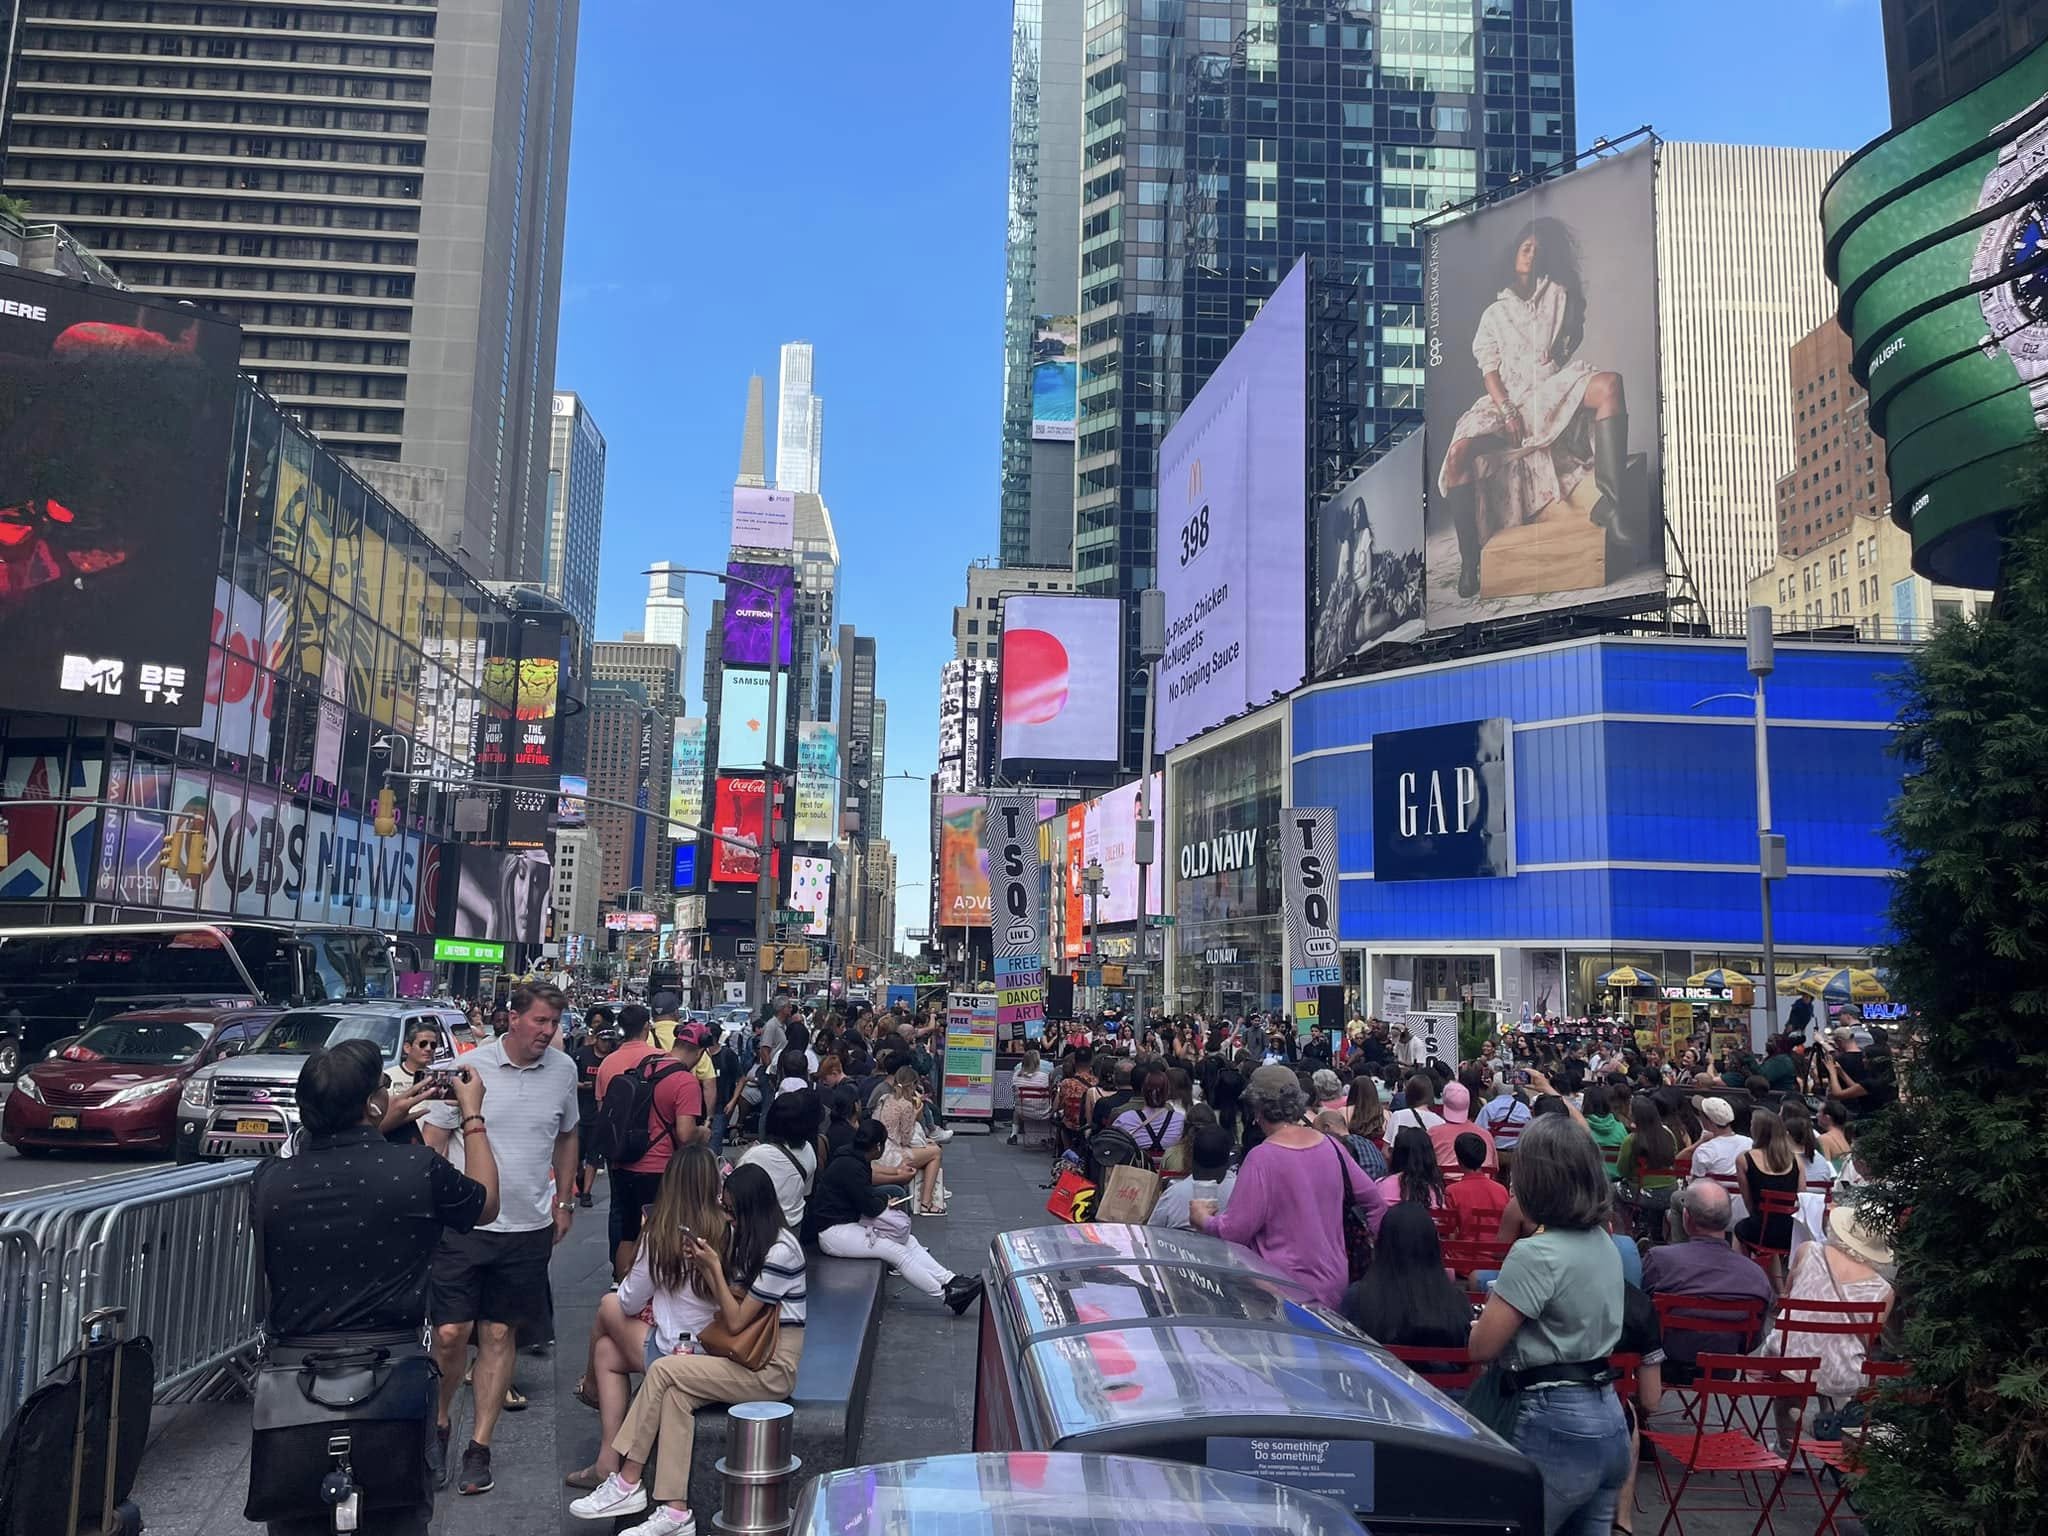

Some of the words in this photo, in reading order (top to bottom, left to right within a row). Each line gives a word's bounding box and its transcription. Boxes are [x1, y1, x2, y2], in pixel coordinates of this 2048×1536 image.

[1879, 337, 1906, 365] LIGHT.
[1181, 505, 1209, 567] 398
[735, 609, 774, 618] OUTFRON
[1165, 613, 1193, 647] 0-Piece
[1193, 583, 1228, 623] Chicken
[1161, 629, 1204, 674] McNuggets
[60, 655, 124, 695] MTV
[1169, 682, 1179, 703] No
[1180, 662, 1211, 696] Dipping
[1212, 641, 1240, 674] Sauce
[733, 677, 770, 686] SAMSUN
[527, 724, 543, 735] THE
[522, 734, 546, 745] SHOW
[1399, 766, 1475, 838] GAP
[103, 832, 115, 872] CBS
[1180, 840, 1209, 880] OLD
[1212, 827, 1258, 873] NAVY
[222, 811, 307, 901] CBS
[315, 830, 416, 916] NEWS
[1001, 806, 1029, 919] TSQ
[1296, 818, 1330, 931] TSQ
[781, 912, 790, 922] W
[793, 911, 804, 921] 44
[1010, 930, 1030, 940] LIVE
[1309, 942, 1332, 951] LIVE
[1206, 949, 1218, 964] OLD
[1219, 947, 1238, 964] NAVY
[1008, 956, 1037, 972] FREE
[1006, 971, 1043, 988] MUSIC
[1309, 968, 1341, 983] FREE
[1661, 987, 1684, 999] VER
[954, 996, 978, 1009] TSQ
[1016, 1005, 1039, 1020] ART
[950, 1017, 969, 1025] FREE
[1251, 1440, 1270, 1450] See
[1272, 1440, 1330, 1453] something?
[1254, 1450, 1269, 1460] Do
[1271, 1451, 1326, 1464] something.
